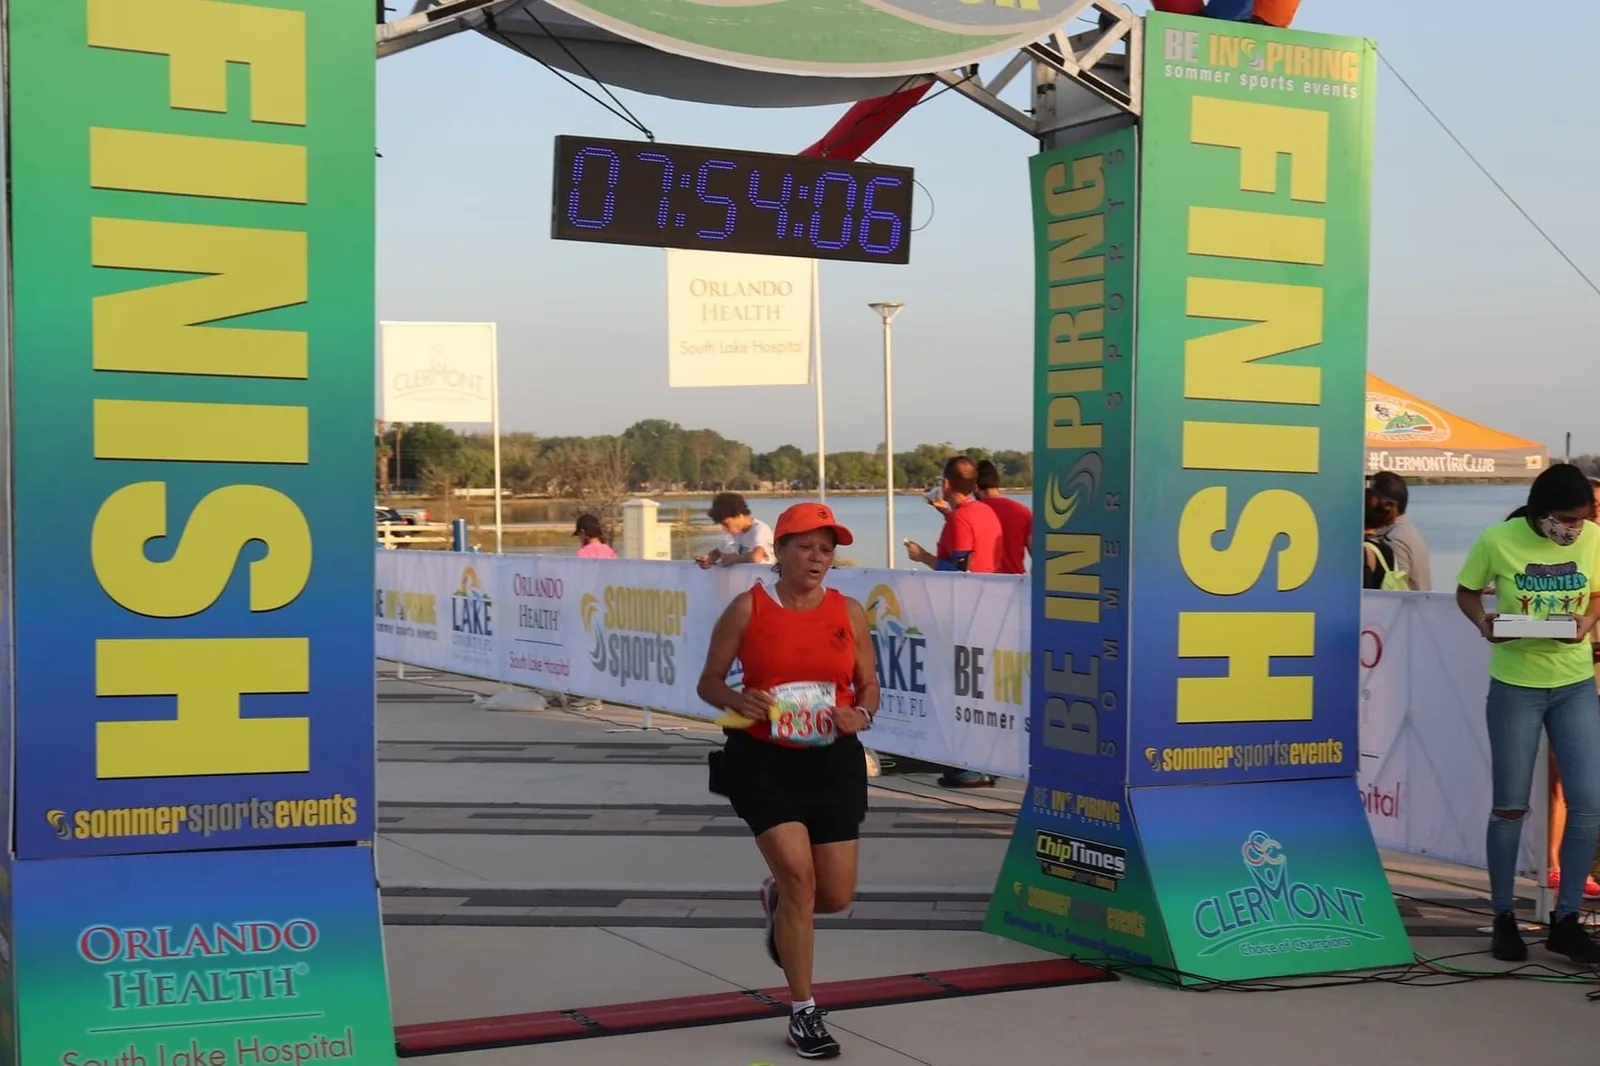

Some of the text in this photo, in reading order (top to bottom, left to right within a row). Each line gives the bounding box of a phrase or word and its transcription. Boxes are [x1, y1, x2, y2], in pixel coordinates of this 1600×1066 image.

[1164, 28, 1199, 63] BE
[1164, 62, 1358, 99] sommer sports events
[567, 146, 902, 254] 07:54:06
[689, 278, 793, 297] ORLANDO
[702, 303, 782, 322] HEALTH
[680, 340, 715, 355] South
[720, 340, 748, 354] Lake
[86, 0, 312, 779] FINISH
[1177, 95, 1329, 723] FINISH
[1101, 148, 1126, 758] SOMMER SPORTS
[513, 573, 564, 599] ORLANDO
[452, 597, 493, 636] LAKE
[519, 604, 558, 631] HEALTH
[604, 585, 687, 636] sommer
[608, 632, 676, 687] sports
[871, 634, 926, 693] AKE
[954, 645, 984, 699] BE
[777, 706, 834, 737] 836
[955, 705, 1015, 730] sommer
[1043, 649, 1099, 757] BE
[1034, 786, 1048, 807] BE
[1036, 834, 1126, 872] ChipTimes
[1195, 864, 1365, 939] CLERMONT
[79, 919, 319, 964] ORLANDO
[1240, 937, 1351, 957] Choice of Champions
[160, 1041, 226, 1066] Lake
[237, 1028, 354, 1066] Hospital
